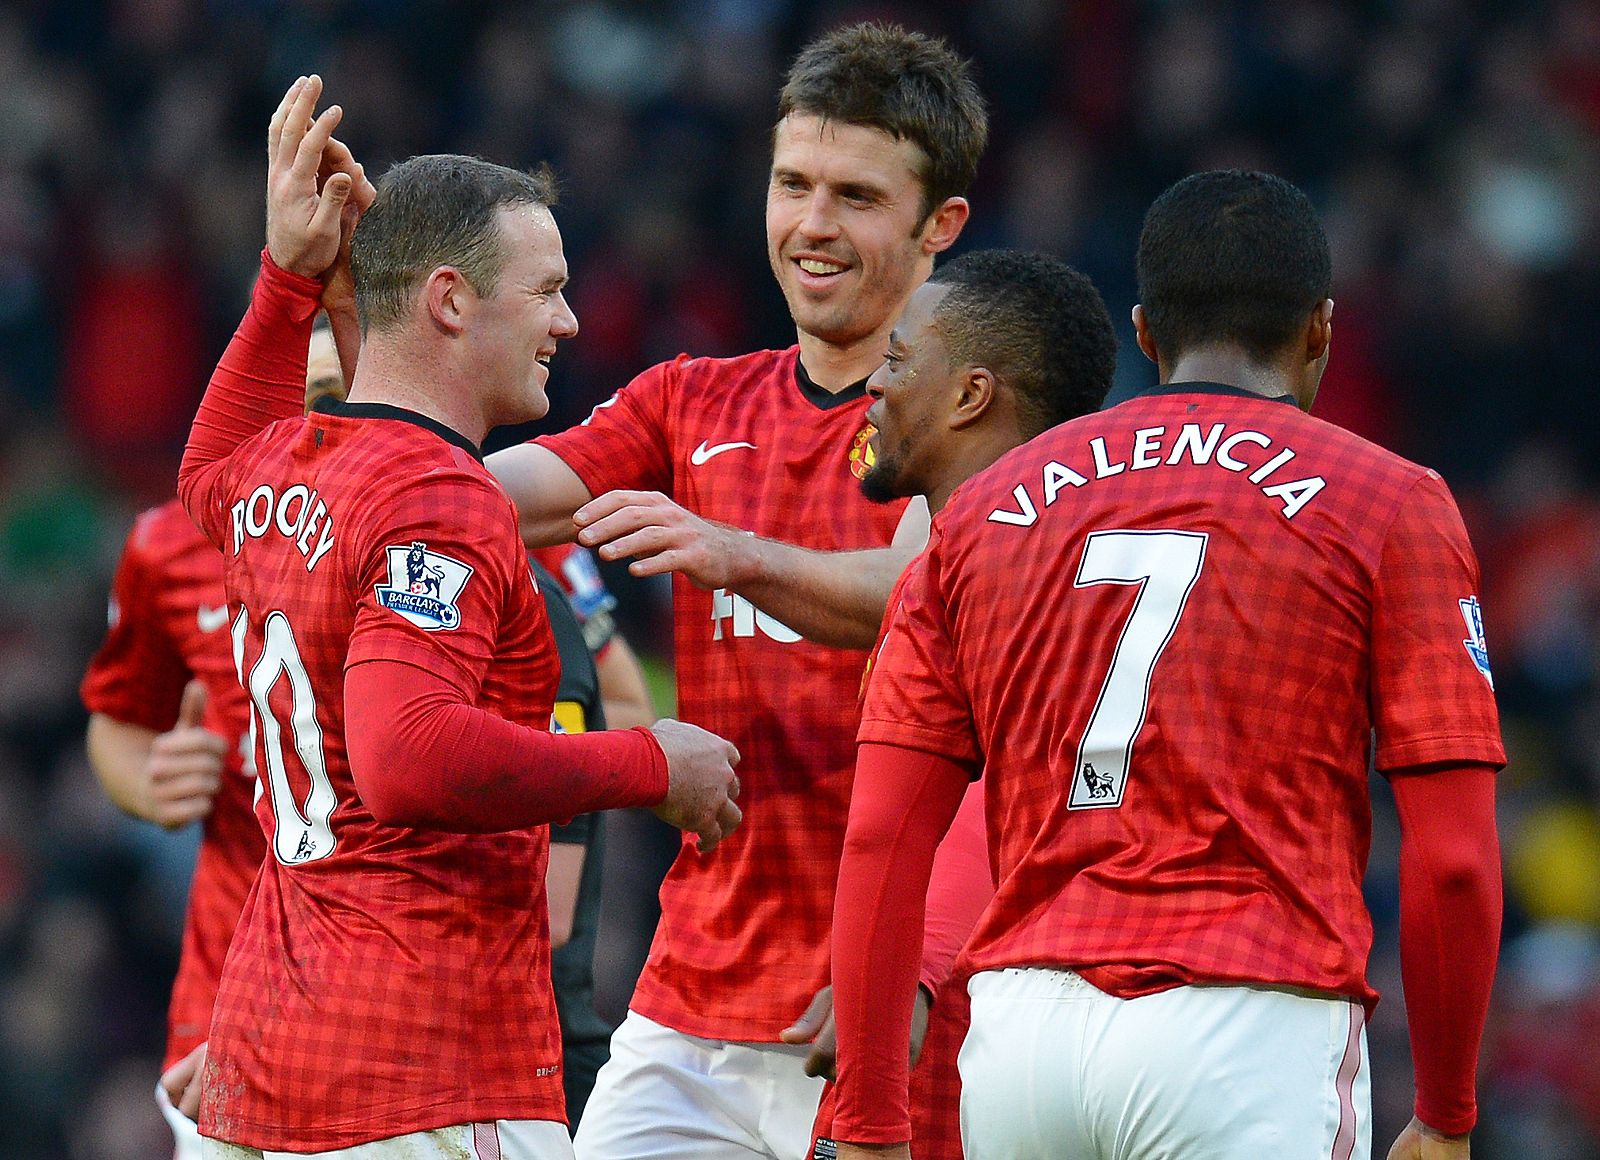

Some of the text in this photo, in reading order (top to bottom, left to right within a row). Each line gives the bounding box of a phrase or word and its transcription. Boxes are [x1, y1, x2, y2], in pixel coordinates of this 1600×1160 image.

[987, 423, 1326, 528] VALENCIA
[388, 592, 440, 612] BARCLAYS
[1067, 528, 1209, 811] 7
